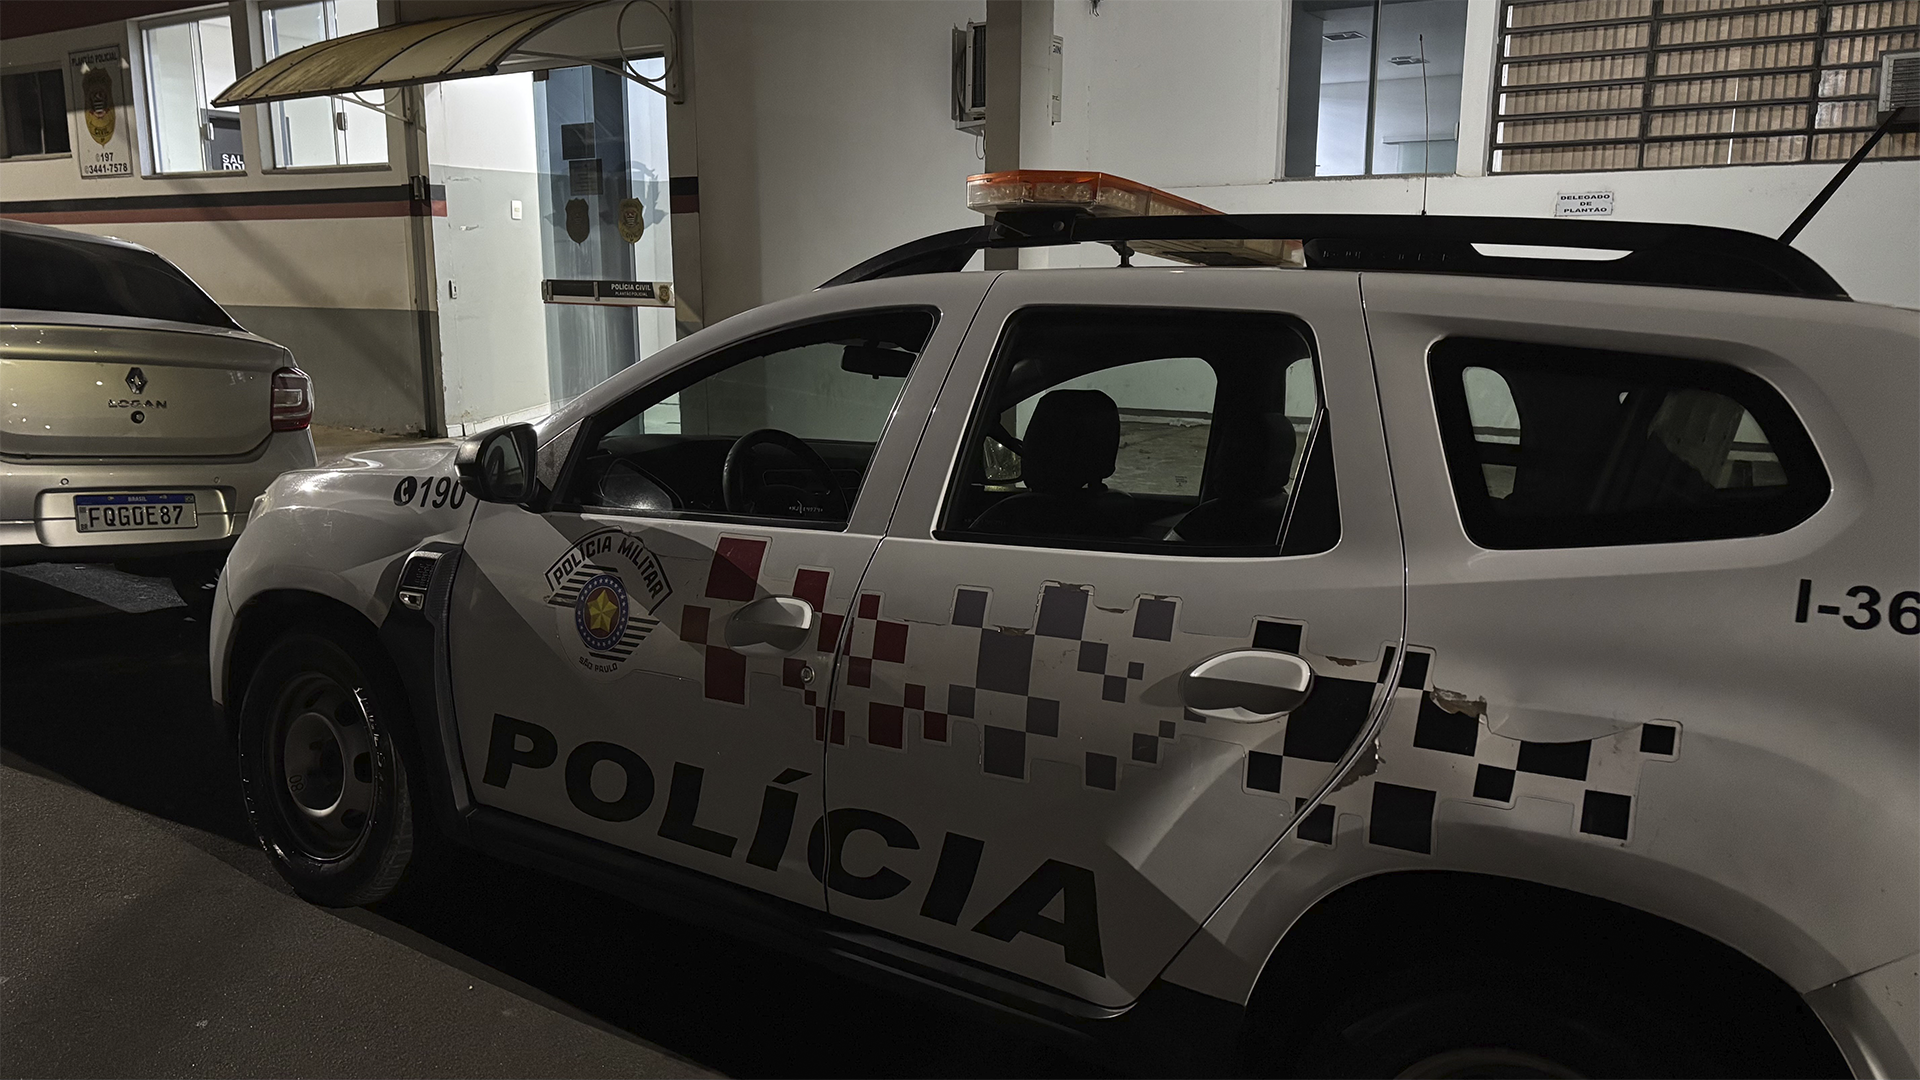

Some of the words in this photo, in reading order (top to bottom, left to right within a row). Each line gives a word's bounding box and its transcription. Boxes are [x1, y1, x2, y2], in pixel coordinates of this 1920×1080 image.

[96, 53, 118, 63] POLICIAL
[100, 152, 114, 162] 197
[88, 163, 128, 174] 3441-7578
[610, 282, 635, 291] POLÍCIA
[108, 399, 167, 409] LOGAN
[420, 476, 467, 510] 190
[552, 536, 612, 585] POLÍCIA
[617, 537, 664, 600] MILITAR
[579, 656, 593, 670] SÃO
[594, 663, 619, 673] PAULO
[483, 712, 1107, 979] POLÍCIA
